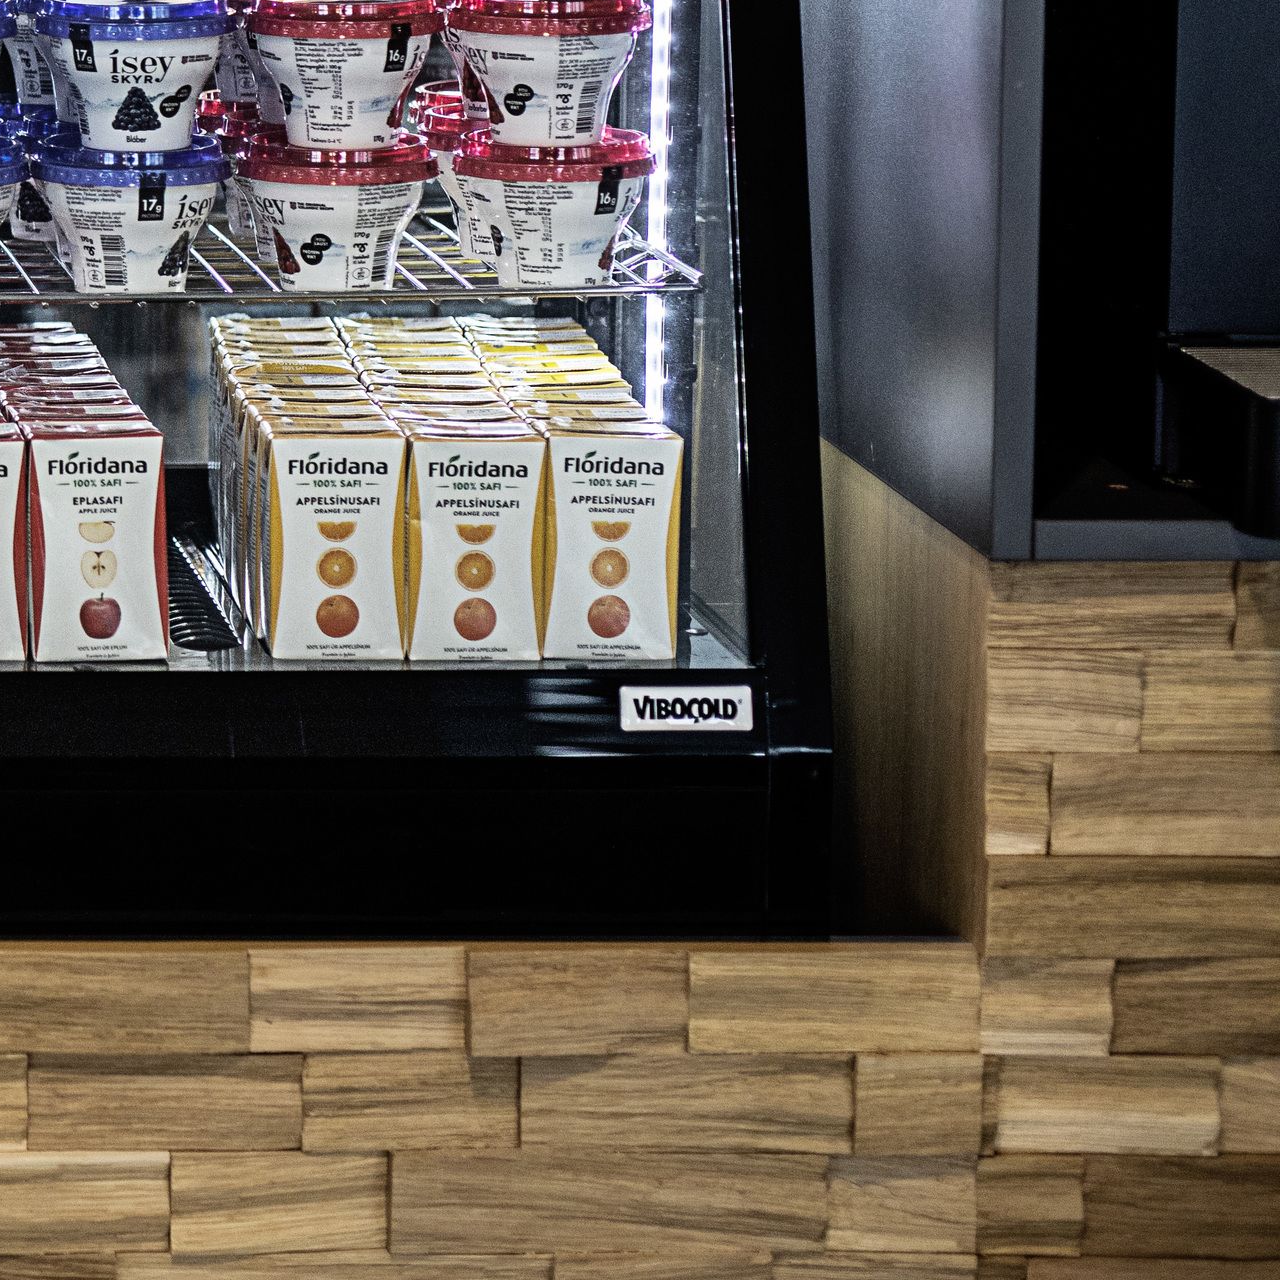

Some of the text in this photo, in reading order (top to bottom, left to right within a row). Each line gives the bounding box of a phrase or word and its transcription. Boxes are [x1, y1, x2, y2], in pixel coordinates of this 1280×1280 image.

[389, 49, 405, 63] 16g
[109, 48, 176, 83] ísey
[111, 74, 153, 84] SKYR
[599, 192, 617, 206] 16g
[141, 199, 163, 213] 17g
[312, 479, 362, 488] 100% SAFI
[588, 478, 638, 488] 100% SAFI
[72, 496, 123, 506] EPLASAFI
[296, 494, 380, 506] APPELSÍNUSAFI
[435, 497, 520, 509] APPELSÍNUSAFI
[570, 493, 655, 507] APPELSÍNUSAFI
[633, 695, 738, 721] VIBOCOLD
